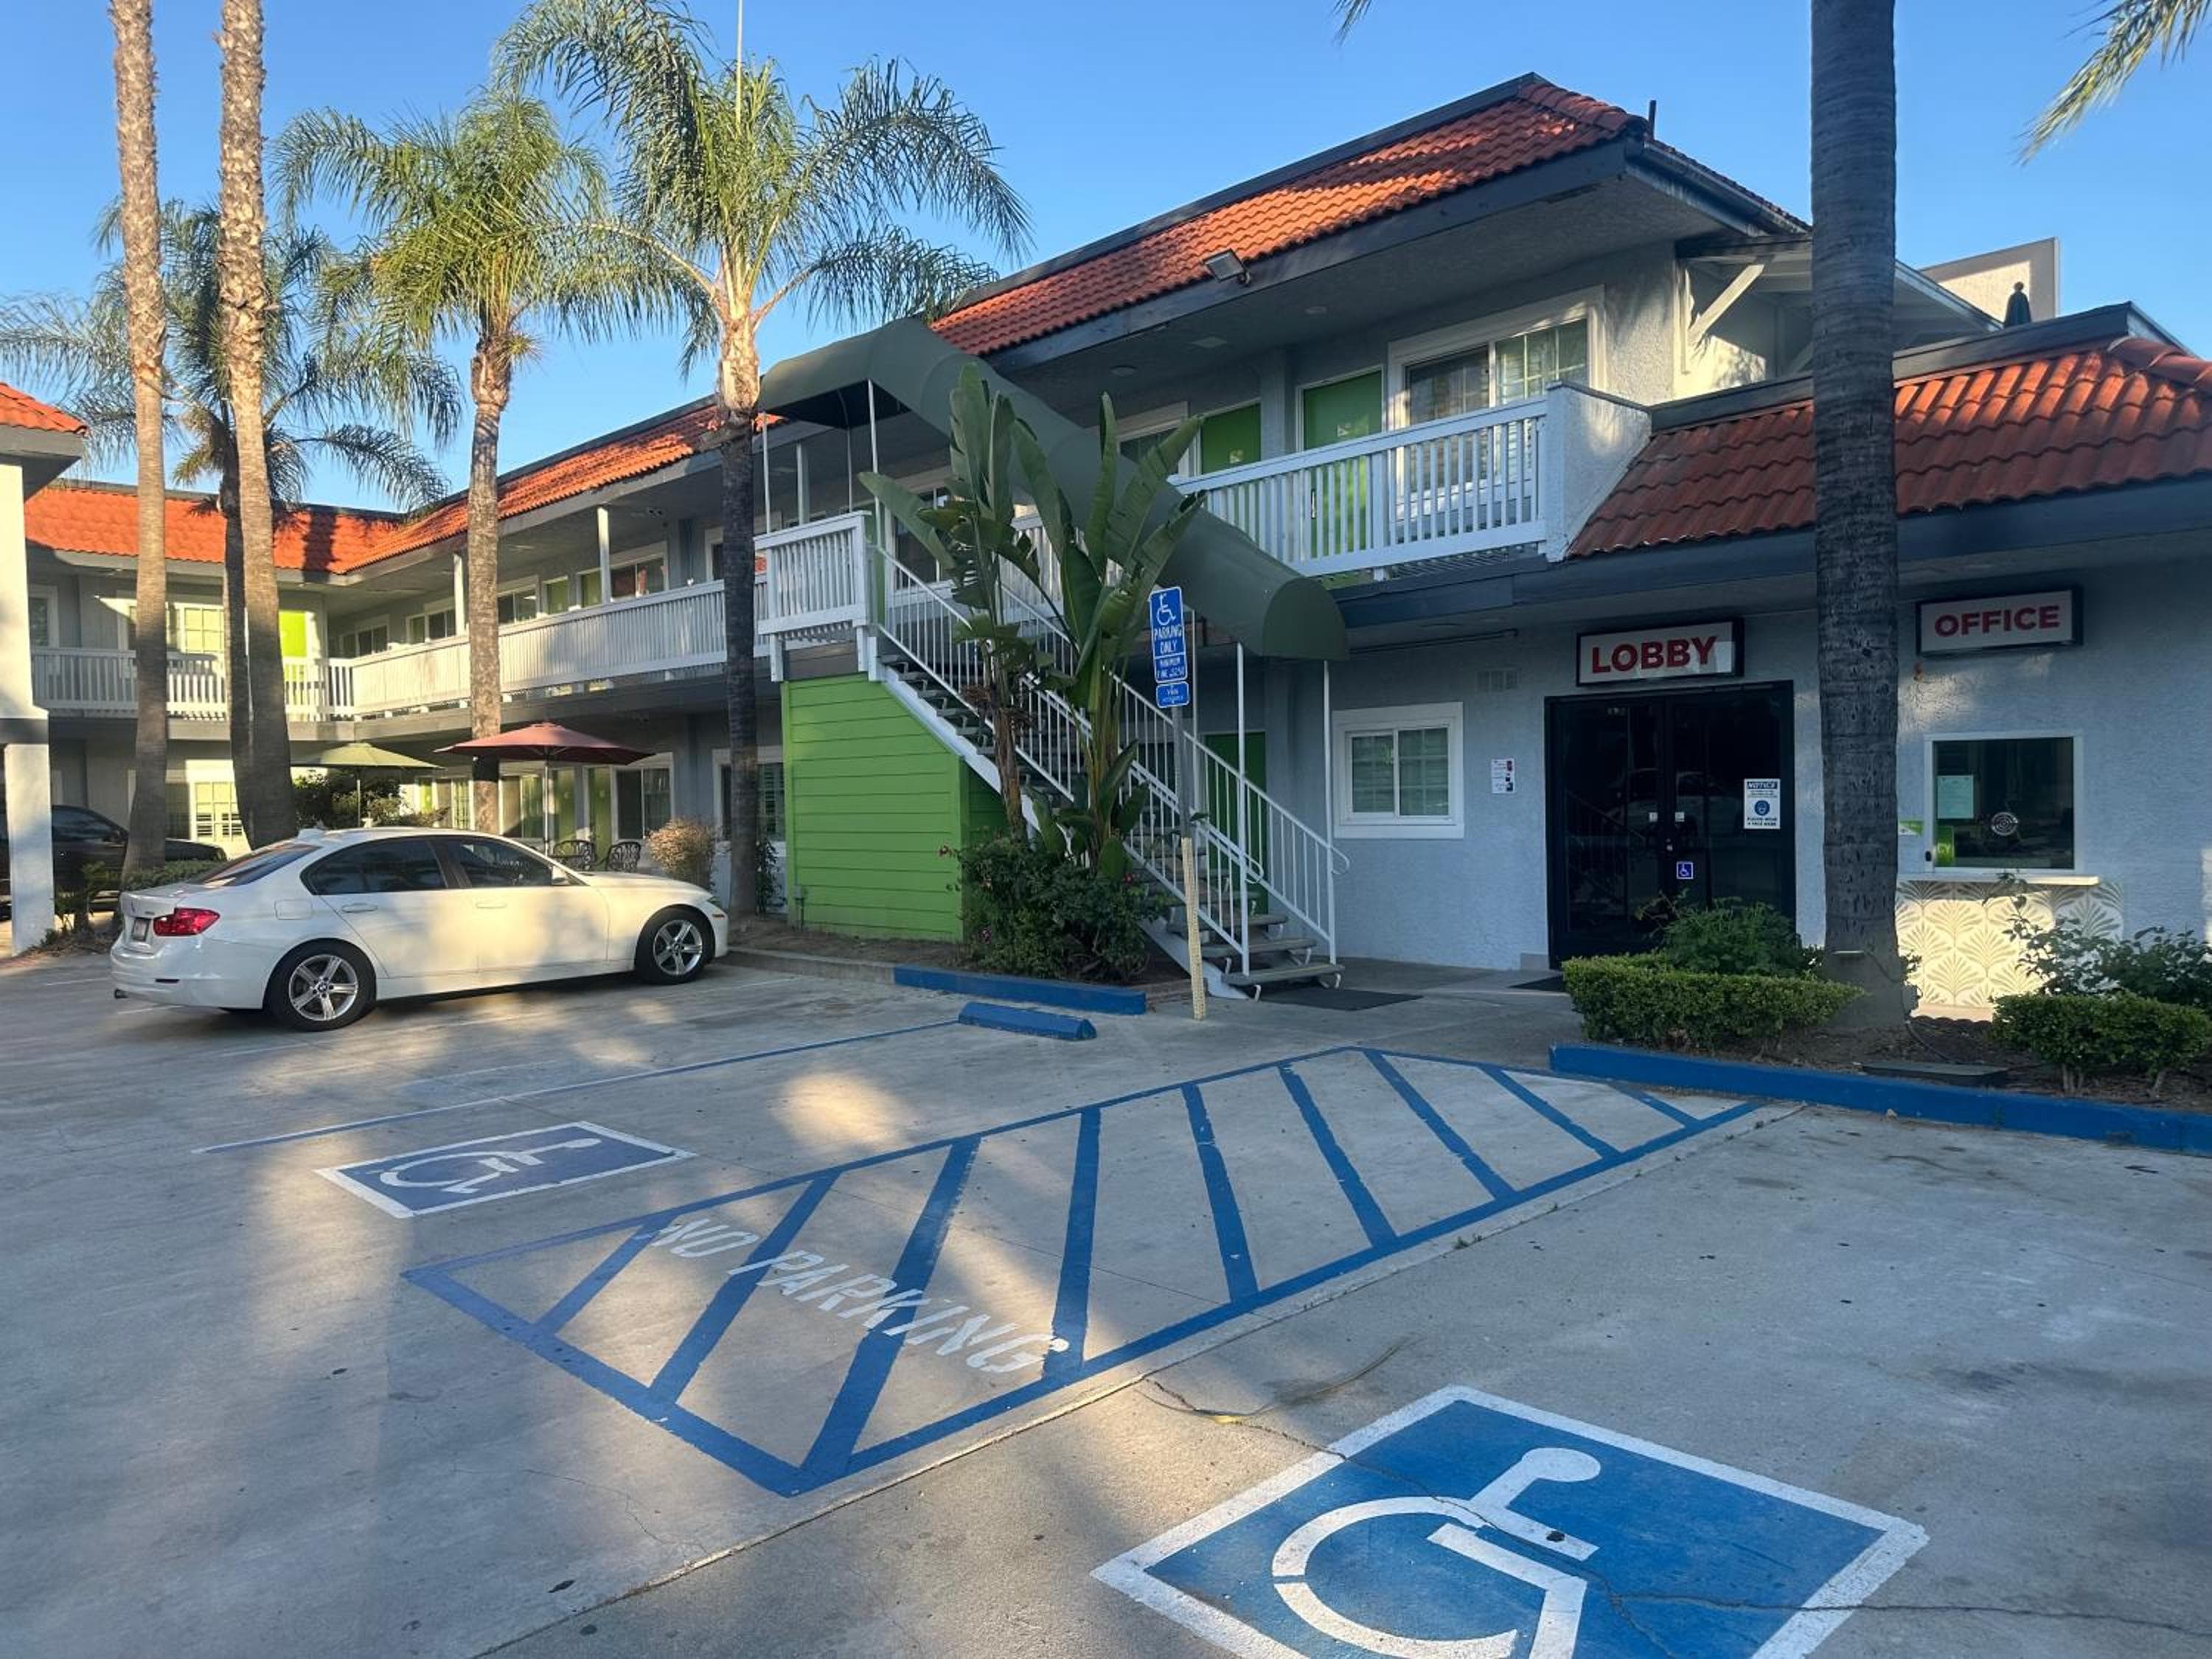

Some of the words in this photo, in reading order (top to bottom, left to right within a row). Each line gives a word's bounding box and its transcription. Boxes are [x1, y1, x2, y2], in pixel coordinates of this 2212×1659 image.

[1154, 625, 1183, 641] PARKING
[1934, 605, 2060, 638] OFFICE
[1160, 639, 1178, 655] ONLY
[1592, 636, 1717, 674] LOBBY
[633, 1218, 760, 1259] NO
[728, 1249, 1070, 1373] PARKING
